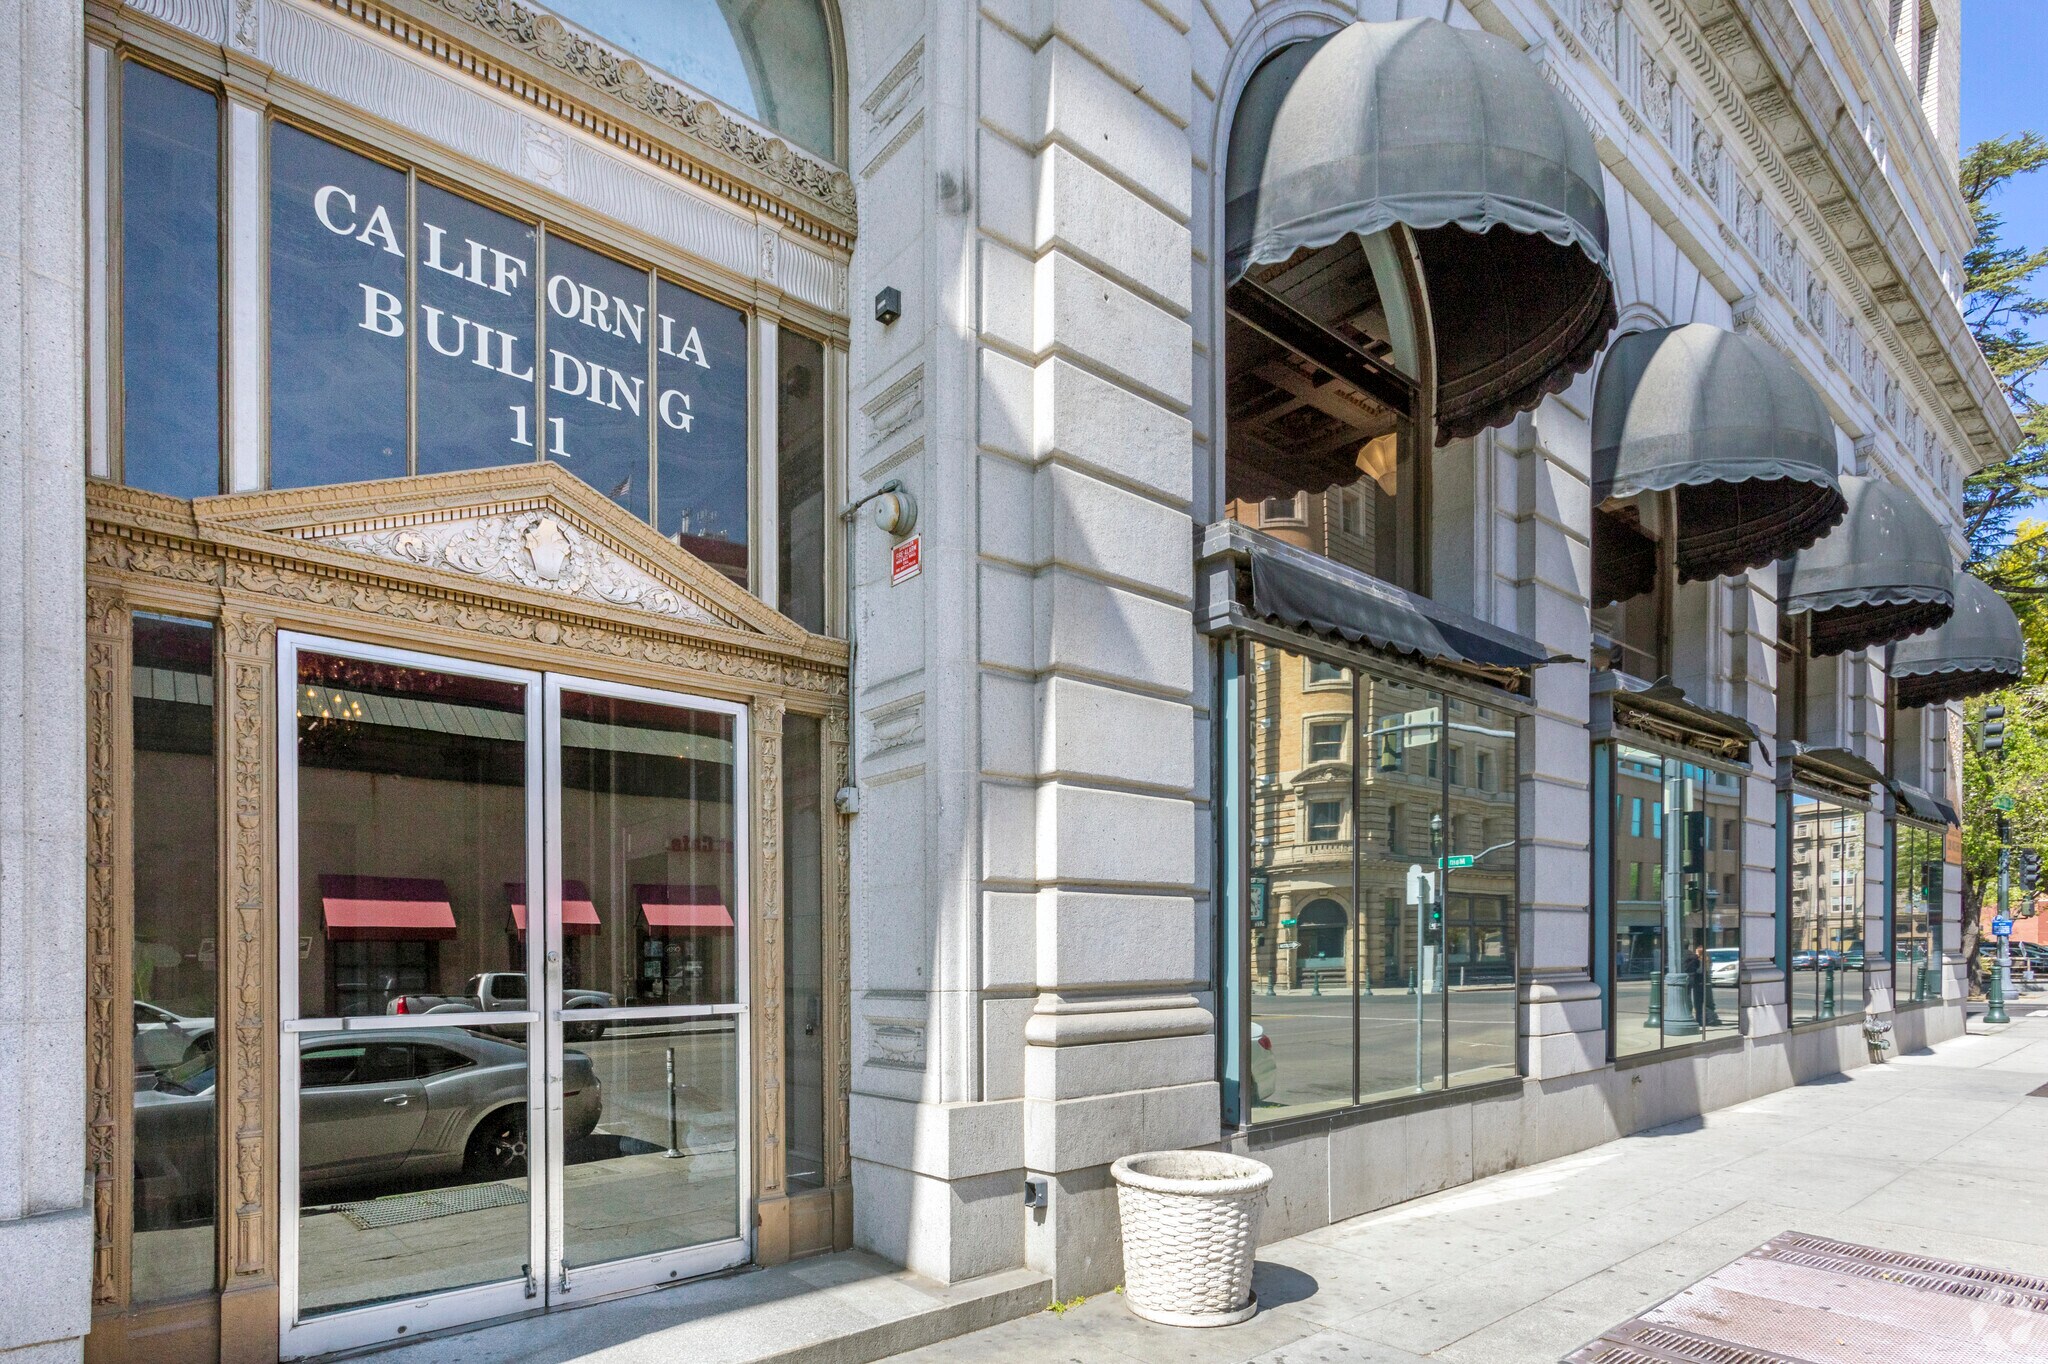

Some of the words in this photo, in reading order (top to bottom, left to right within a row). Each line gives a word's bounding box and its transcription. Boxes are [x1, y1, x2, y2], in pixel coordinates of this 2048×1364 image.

[313, 185, 711, 369] CALIFORNIA
[358, 282, 695, 433] BUILDING
[509, 405, 571, 458] 11
